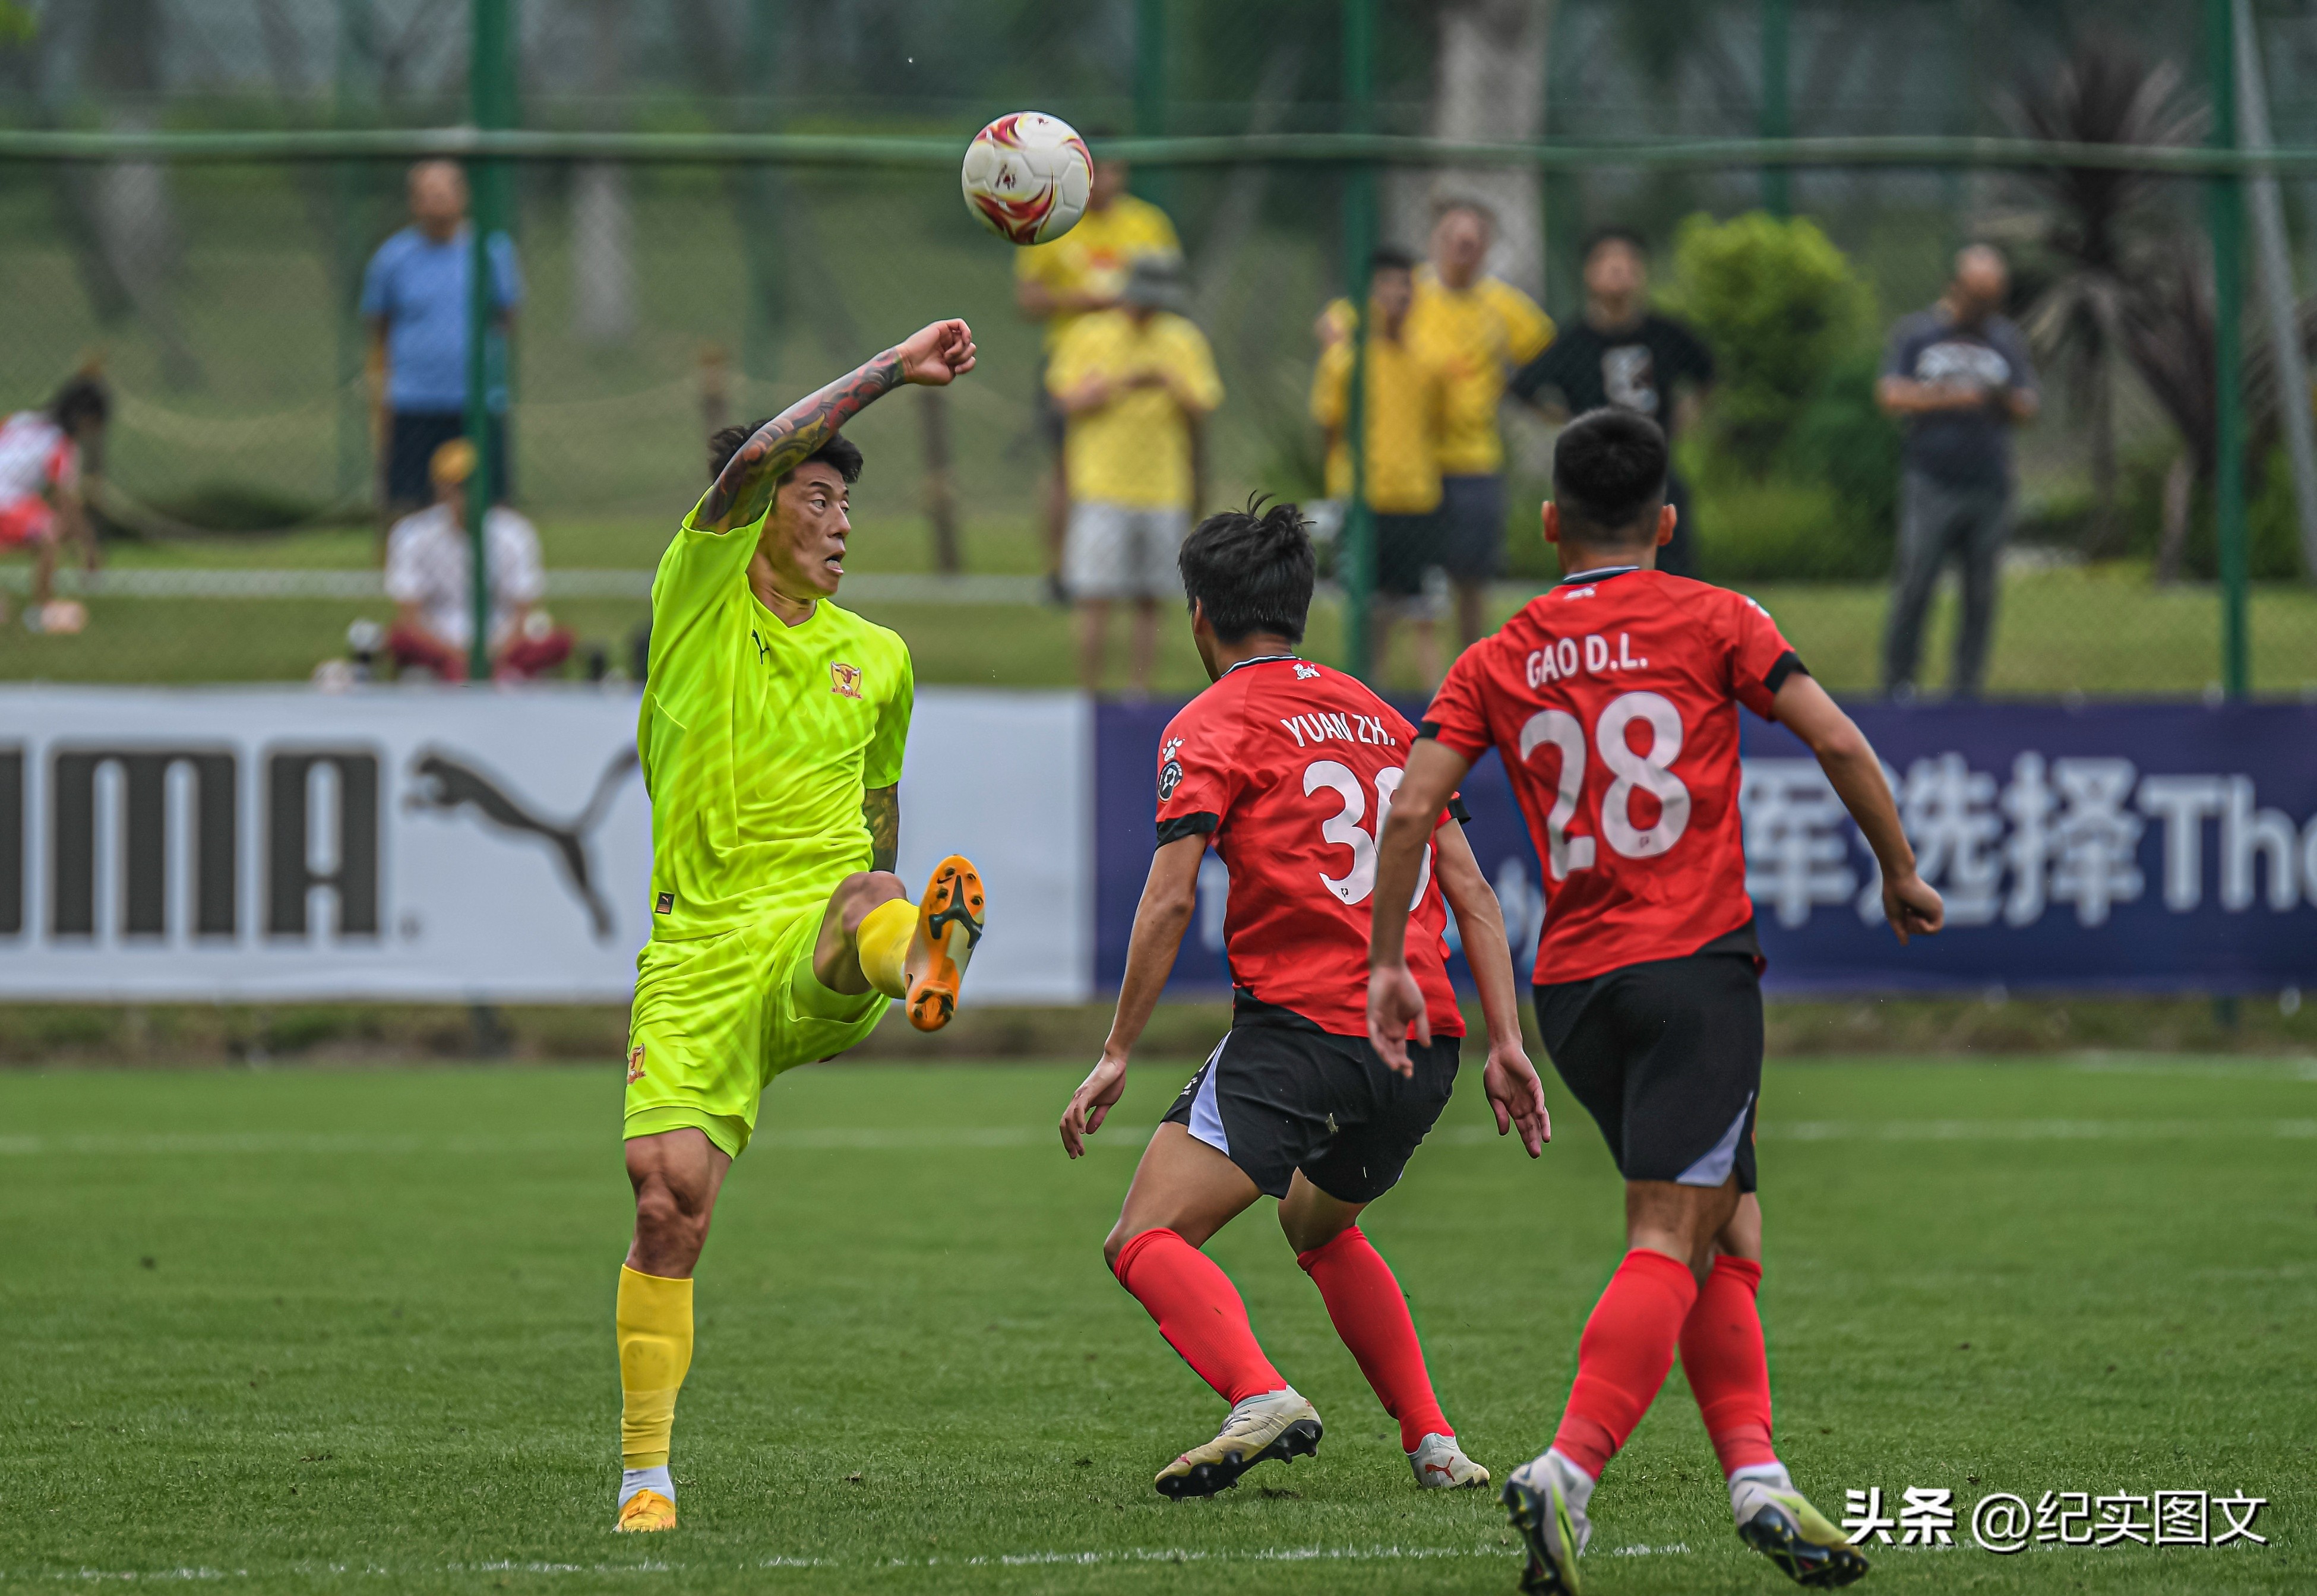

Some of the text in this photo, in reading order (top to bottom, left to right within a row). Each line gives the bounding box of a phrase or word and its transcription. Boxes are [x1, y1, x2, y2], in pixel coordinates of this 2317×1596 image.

[1280, 712, 1396, 747] YUAN ZH.
[1526, 632, 1648, 689] GAO D.L.
[0, 742, 383, 943] MA
[1519, 690, 1691, 881] 28
[2139, 774, 2317, 915] Th
